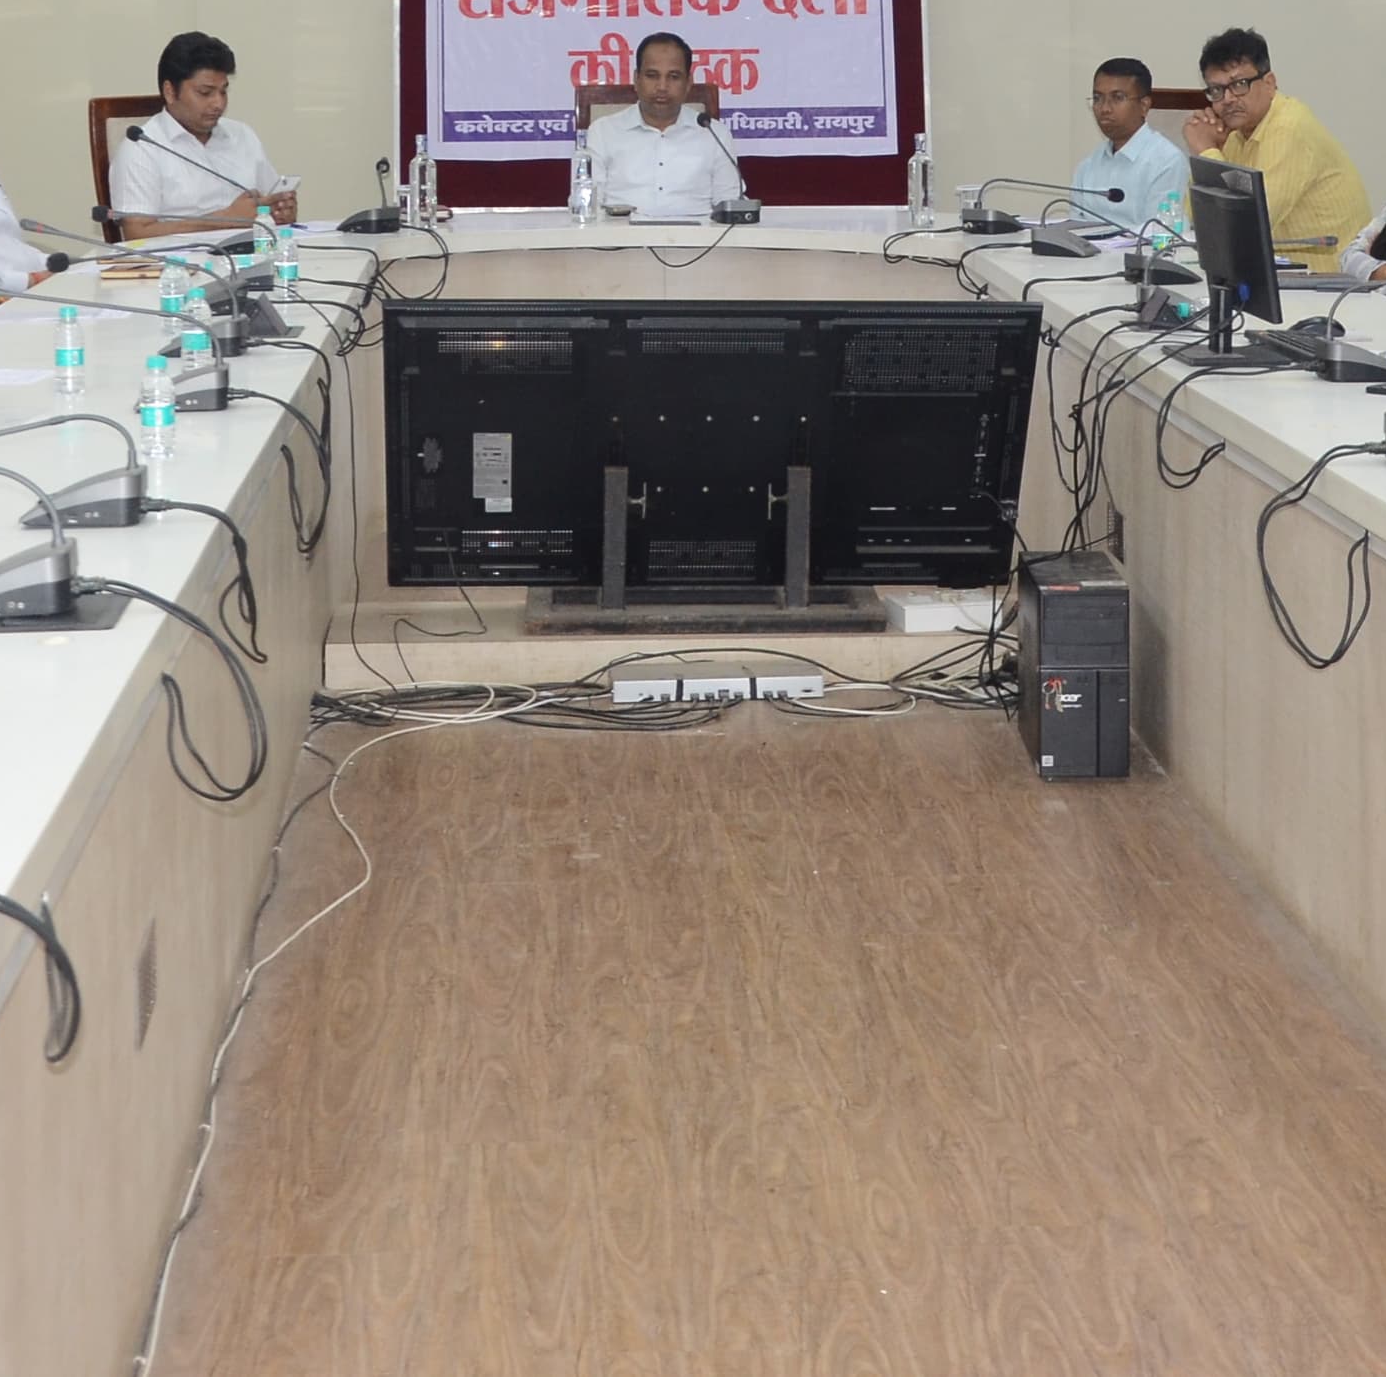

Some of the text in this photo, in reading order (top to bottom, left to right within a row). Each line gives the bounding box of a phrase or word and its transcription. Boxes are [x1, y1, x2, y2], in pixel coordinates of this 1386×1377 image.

[567, 32, 633, 86] की
[453, 113, 570, 135] कलेक्टर एवं
[813, 115, 876, 134] रायपुर
